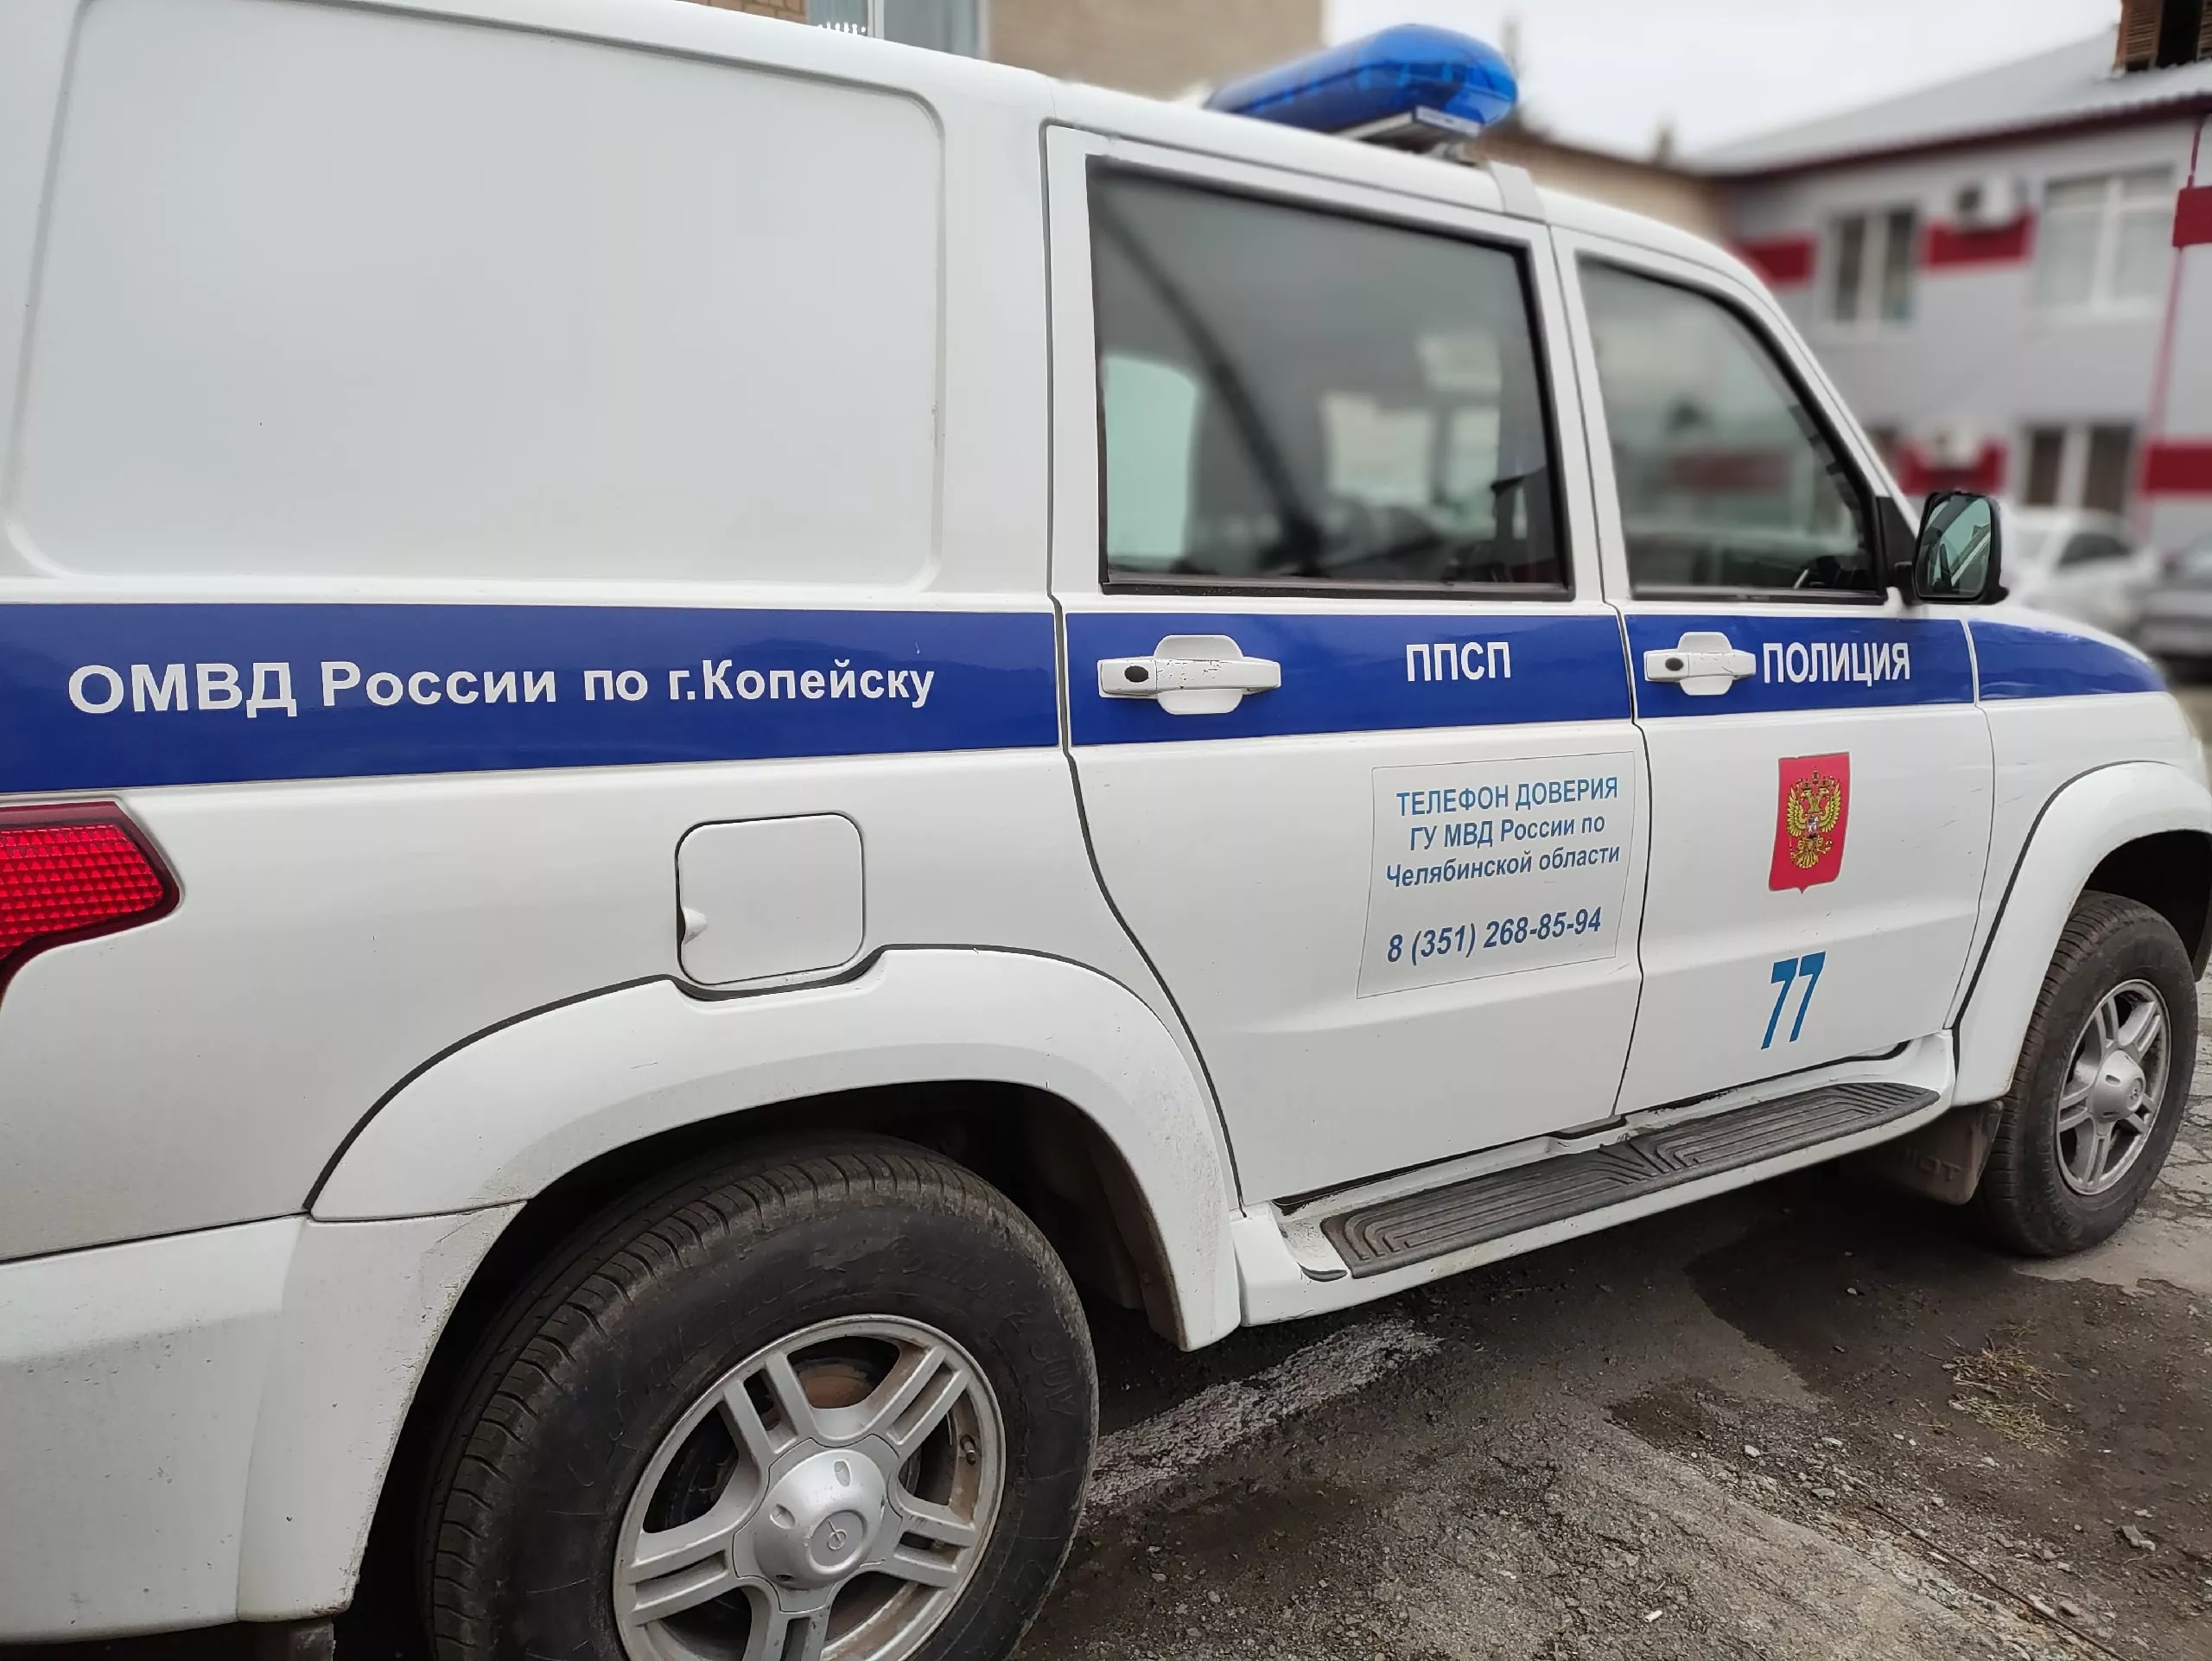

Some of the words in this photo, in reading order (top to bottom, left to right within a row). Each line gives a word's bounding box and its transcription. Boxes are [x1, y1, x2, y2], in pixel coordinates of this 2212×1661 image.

[1406, 641, 1512, 683] ППСП
[1763, 642, 1911, 687] ПОЛИЦИЯ
[68, 661, 297, 718] ОМВД
[321, 660, 556, 706] России
[583, 670, 648, 702] по
[668, 659, 936, 709] г.Копейску
[1395, 785, 1509, 816] ТЕЛЕФОН
[1515, 776, 1618, 811] ДОВЕРИЯ
[1410, 825, 1438, 851] ГУ
[1444, 820, 1493, 849] МВД
[1500, 818, 1574, 842] России
[1581, 816, 1605, 834] по
[1386, 850, 1532, 888] Челябинской
[1539, 846, 1620, 870] области
[1387, 933, 1403, 963] 8
[1411, 923, 1476, 966] (351)
[1483, 907, 1602, 948] 268-85-94
[1760, 951, 1827, 1051] 77
